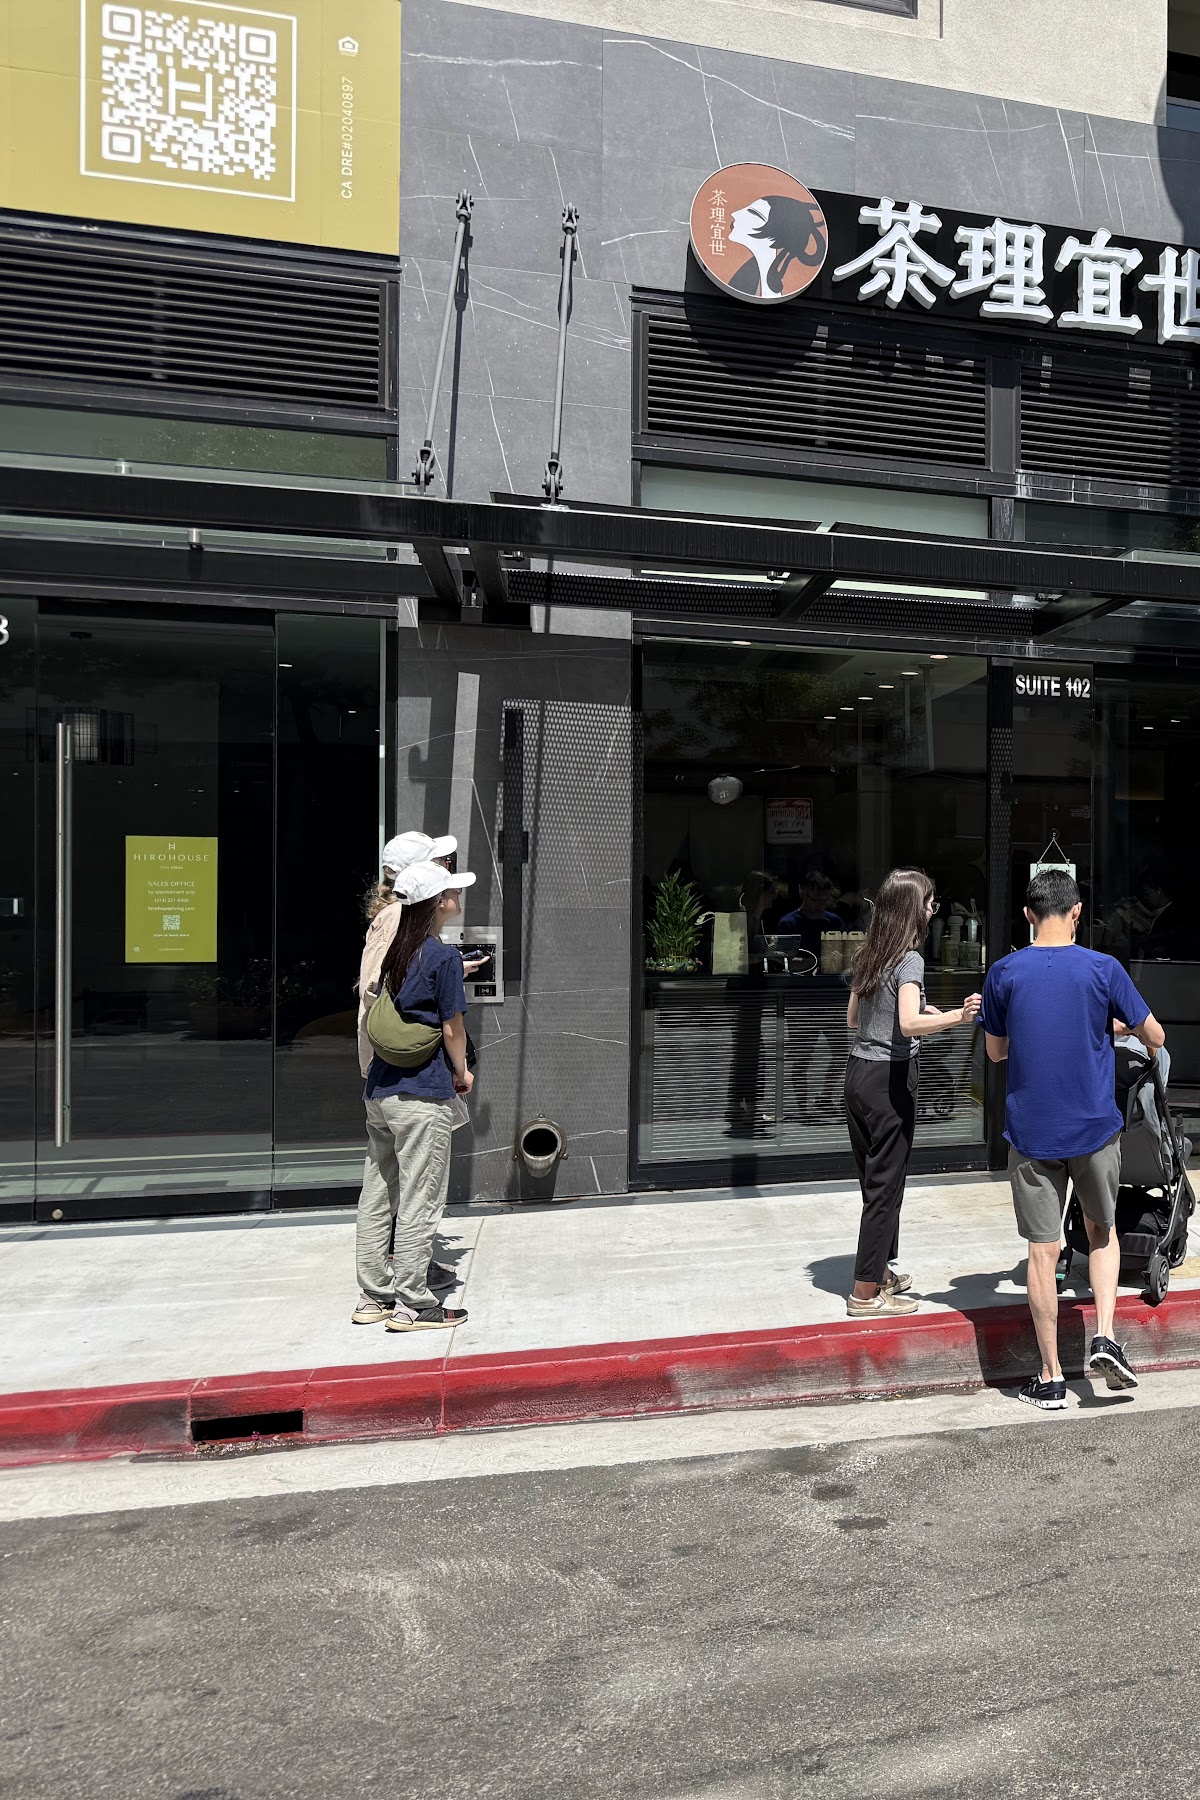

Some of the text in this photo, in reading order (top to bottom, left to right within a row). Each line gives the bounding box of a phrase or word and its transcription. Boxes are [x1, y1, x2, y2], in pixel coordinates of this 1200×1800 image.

[341, 78, 354, 200] CA DRE#02040897
[708, 189, 728, 256] 茶理宜世
[1015, 674, 1091, 698] SUITE 102
[133, 853, 209, 862] HIROHOUSE
